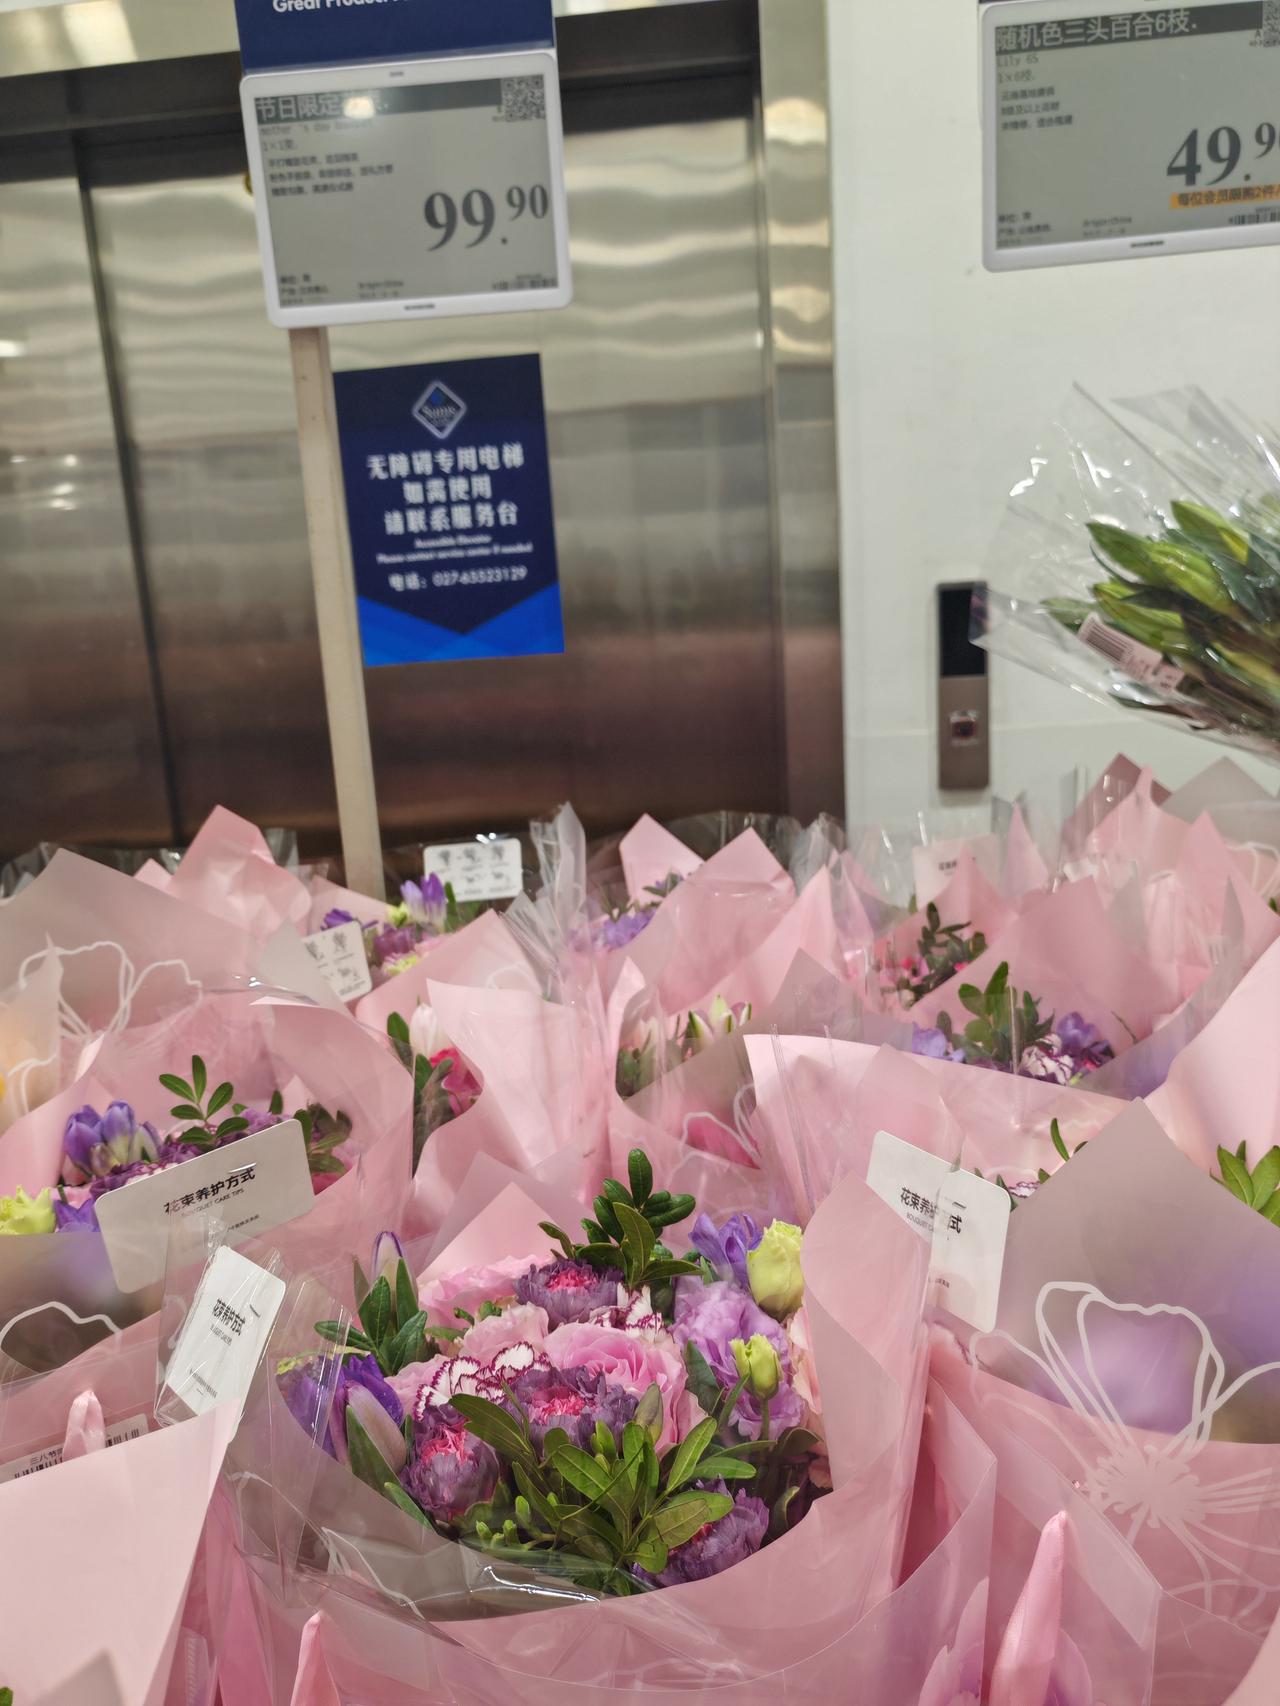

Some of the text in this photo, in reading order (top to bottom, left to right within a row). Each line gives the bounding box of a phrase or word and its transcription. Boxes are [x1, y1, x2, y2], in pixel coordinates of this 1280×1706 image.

[424, 184, 548, 251] 99.90
[366, 441, 524, 480] 无障碍专用电梯
[403, 474, 492, 504] 如需使用
[384, 500, 518, 535] 请联系服务台
[164, 1168, 255, 1214] 花束养护方式
